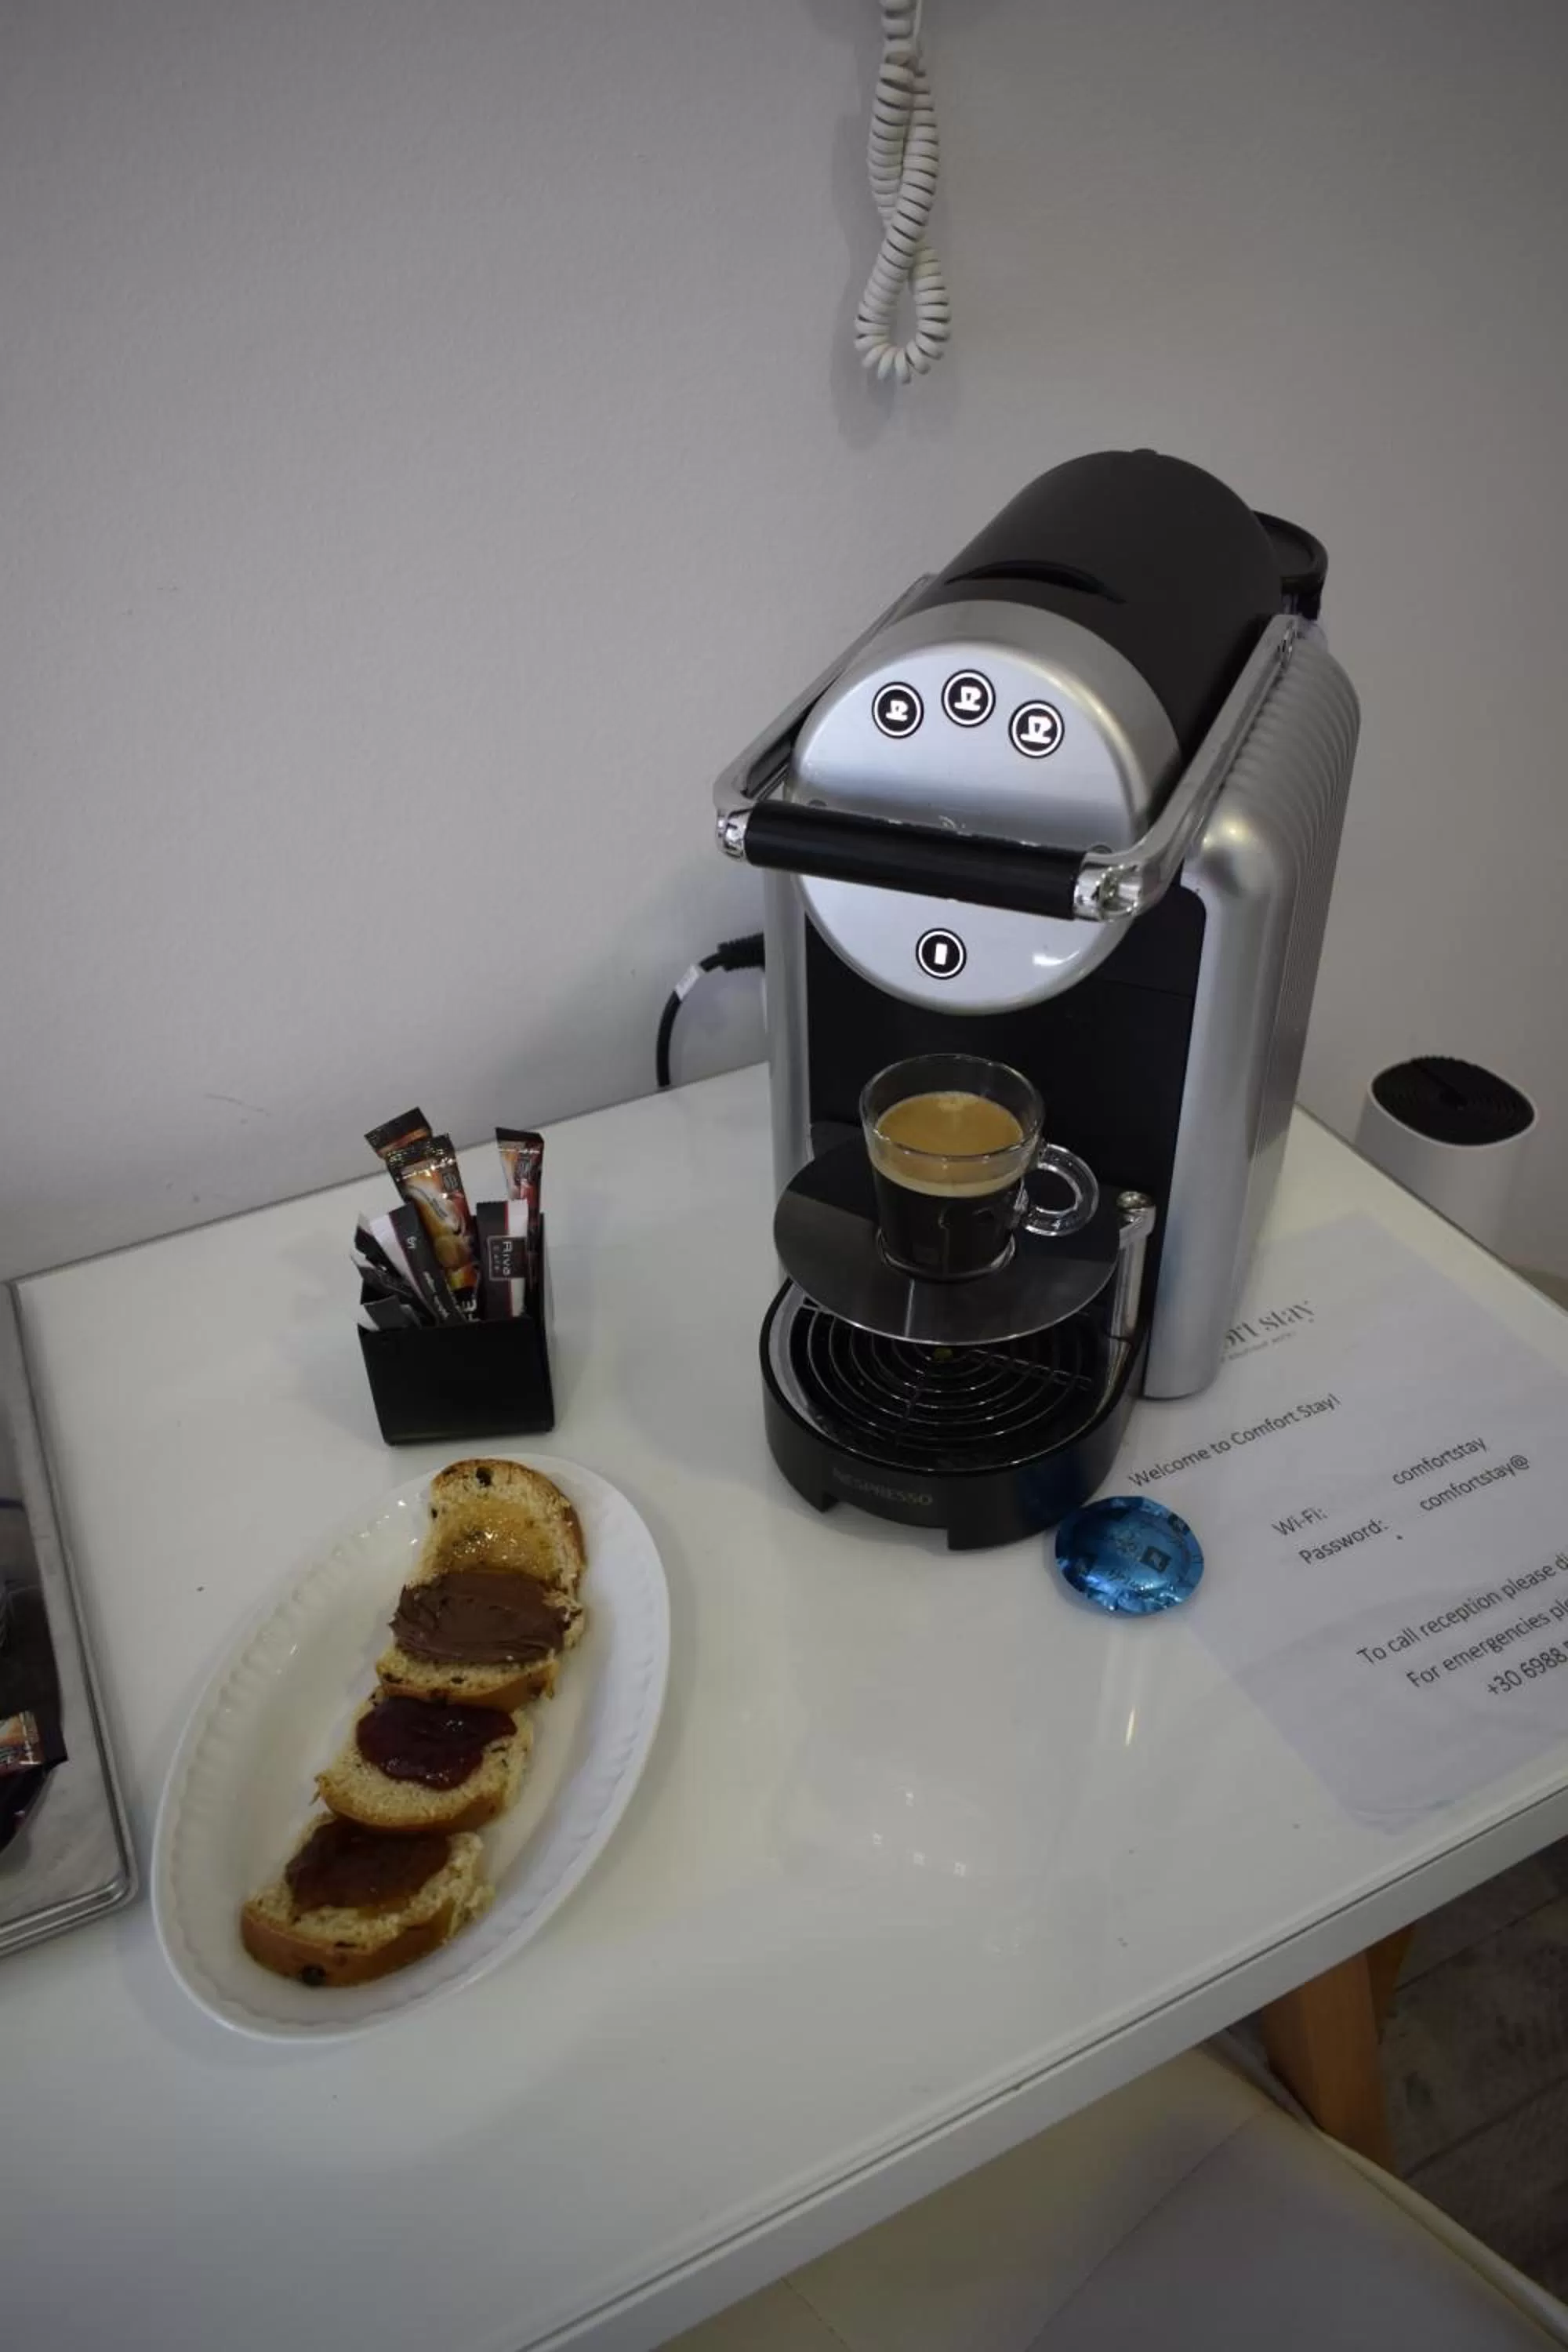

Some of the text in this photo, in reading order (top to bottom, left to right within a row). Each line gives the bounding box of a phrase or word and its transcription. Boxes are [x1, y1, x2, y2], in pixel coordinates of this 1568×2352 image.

[1128, 1393, 1341, 1487] Welcome to Comfort Stay!
[1271, 1437, 1488, 1537] Wi-Fi: comfortstay
[1298, 1454, 1530, 1564] Password: comfortstay@
[1356, 1647, 1387, 1664] To
[1388, 1627, 1421, 1653] call
[1420, 1591, 1503, 1637] reception
[1501, 1565, 1556, 1600] please
[1406, 1665, 1441, 1687] For
[1443, 1613, 1551, 1671] emergencies
[1488, 1647, 1567, 1694] +30 6988
